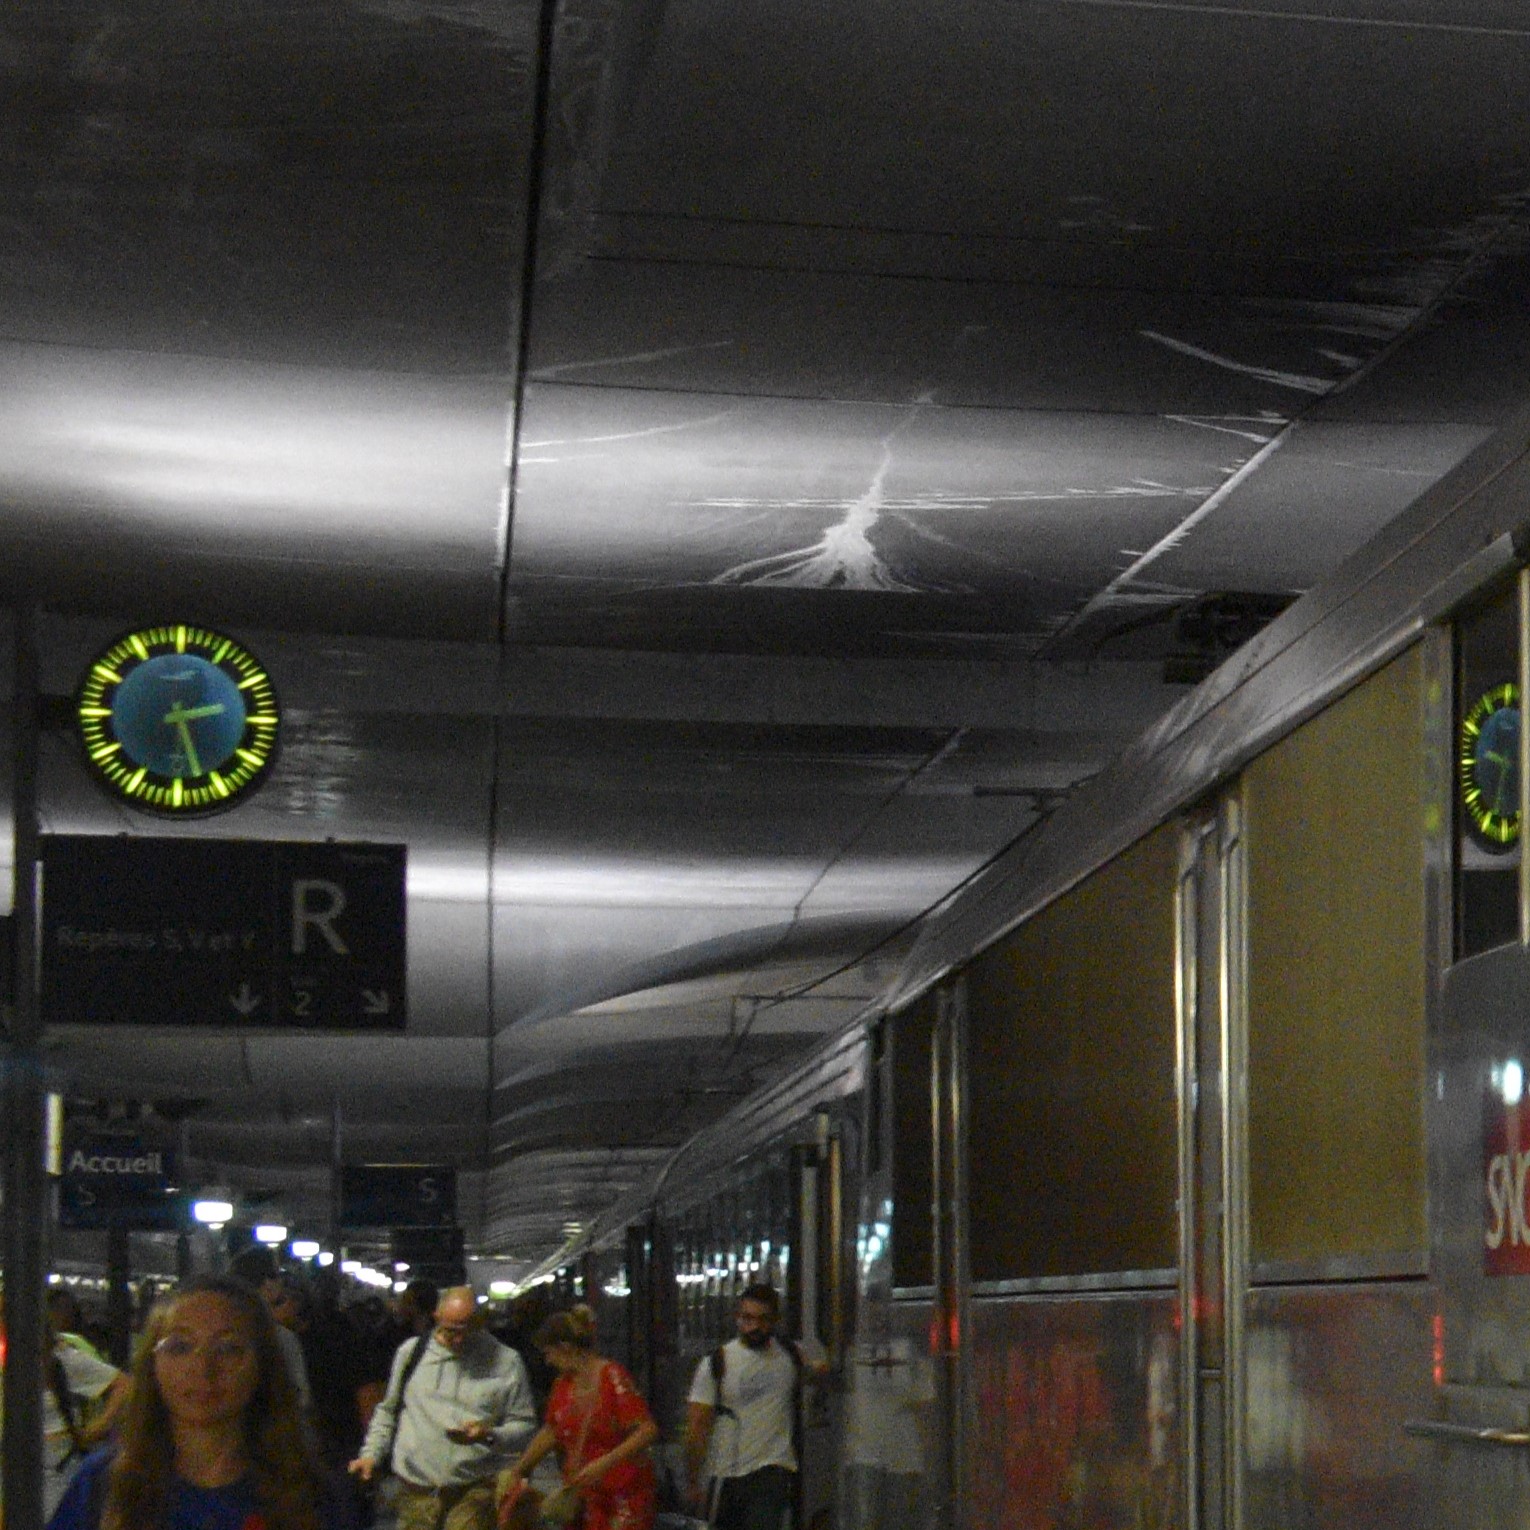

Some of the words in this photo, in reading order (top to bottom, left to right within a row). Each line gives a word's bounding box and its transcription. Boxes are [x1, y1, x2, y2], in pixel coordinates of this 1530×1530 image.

[290, 878, 351, 955] R
[294, 990, 312, 1016] 2
[68, 1150, 162, 1174] Accueil
[418, 1177, 438, 1203] S
